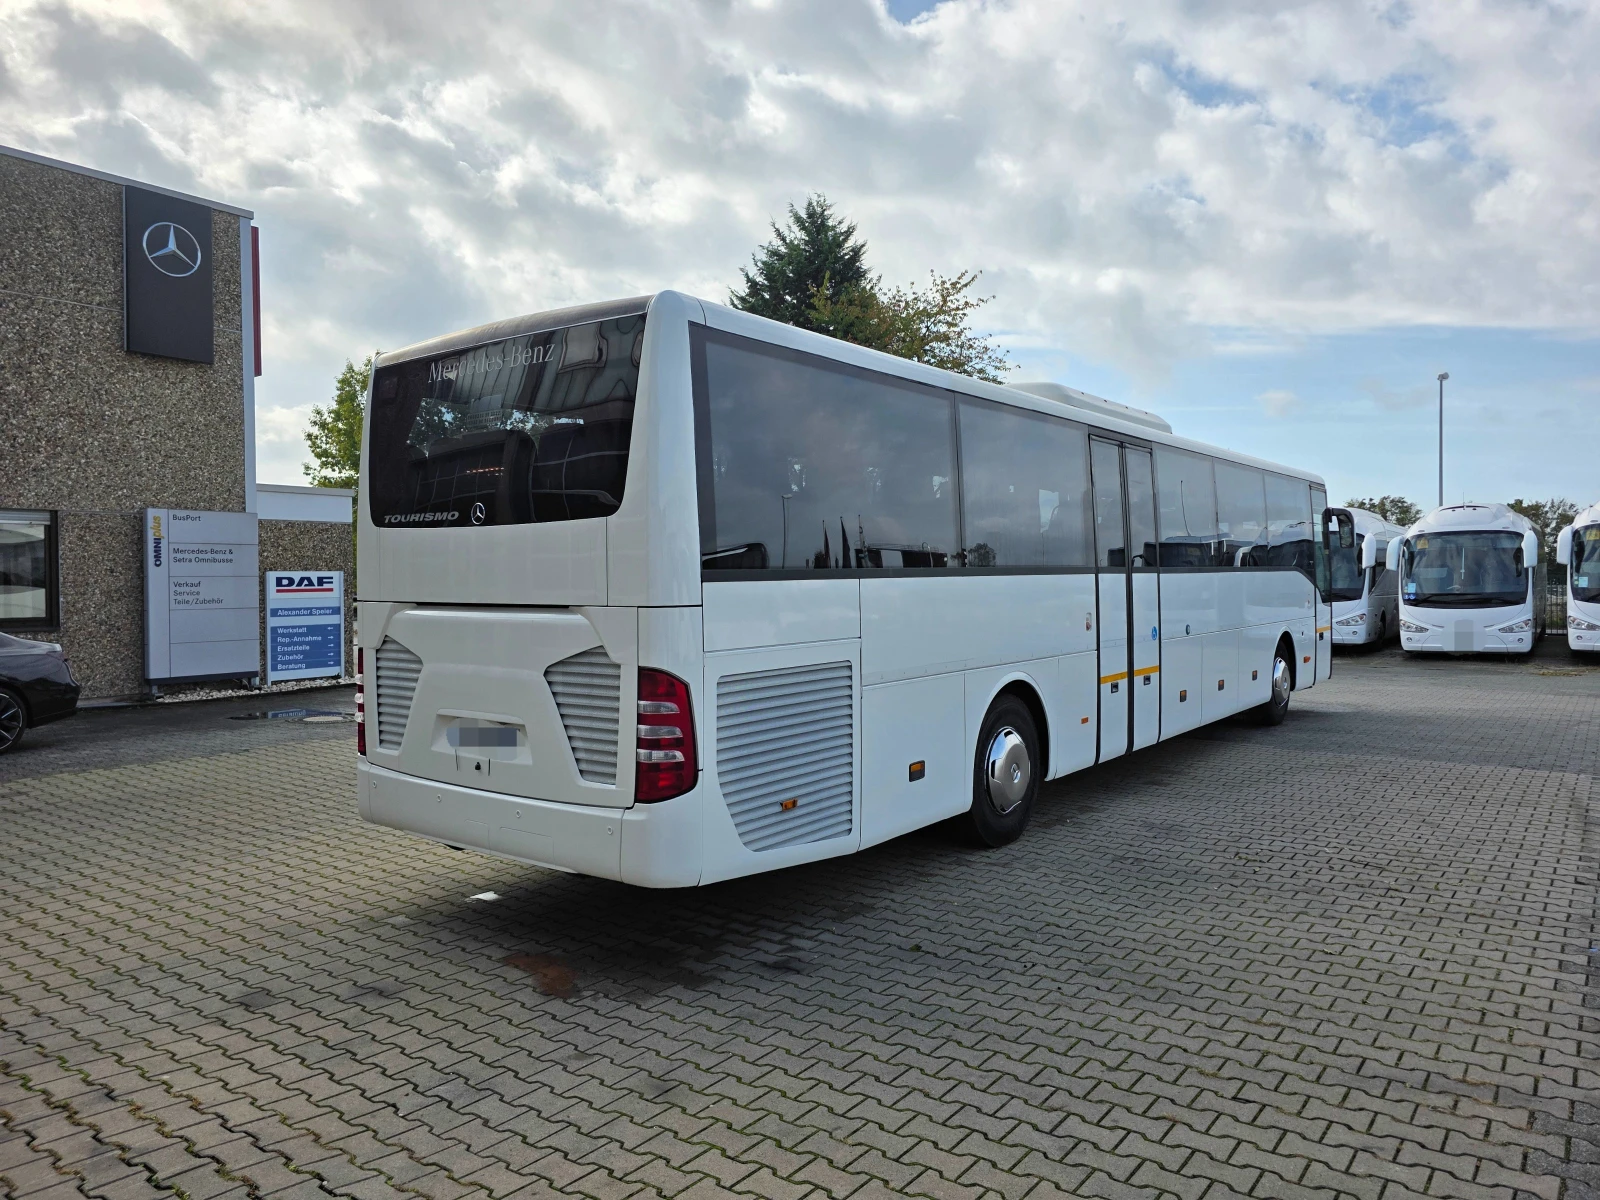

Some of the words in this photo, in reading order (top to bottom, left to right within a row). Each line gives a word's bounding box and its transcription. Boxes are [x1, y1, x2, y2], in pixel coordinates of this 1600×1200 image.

[428, 343, 555, 383] Mercedes-Benz
[172, 514, 202, 522] BusPort
[384, 511, 459, 523] TOURISMO
[150, 515, 165, 567] OMNIplus
[172, 547, 228, 555] Mercedes-Benz
[172, 556, 193, 564] Setra
[194, 556, 234, 564] Omnibusse
[275, 576, 334, 588] DAF
[173, 589, 201, 597] Service
[173, 597, 224, 605] Teile/Zubehör
[311, 608, 333, 616] Speier
[277, 626, 307, 634] Werkstatt
[277, 635, 322, 643] Rep.-Annahme
[277, 644, 310, 652] Ersatzteile
[277, 653, 304, 661] Zubehör
[277, 662, 306, 670] Beratung
